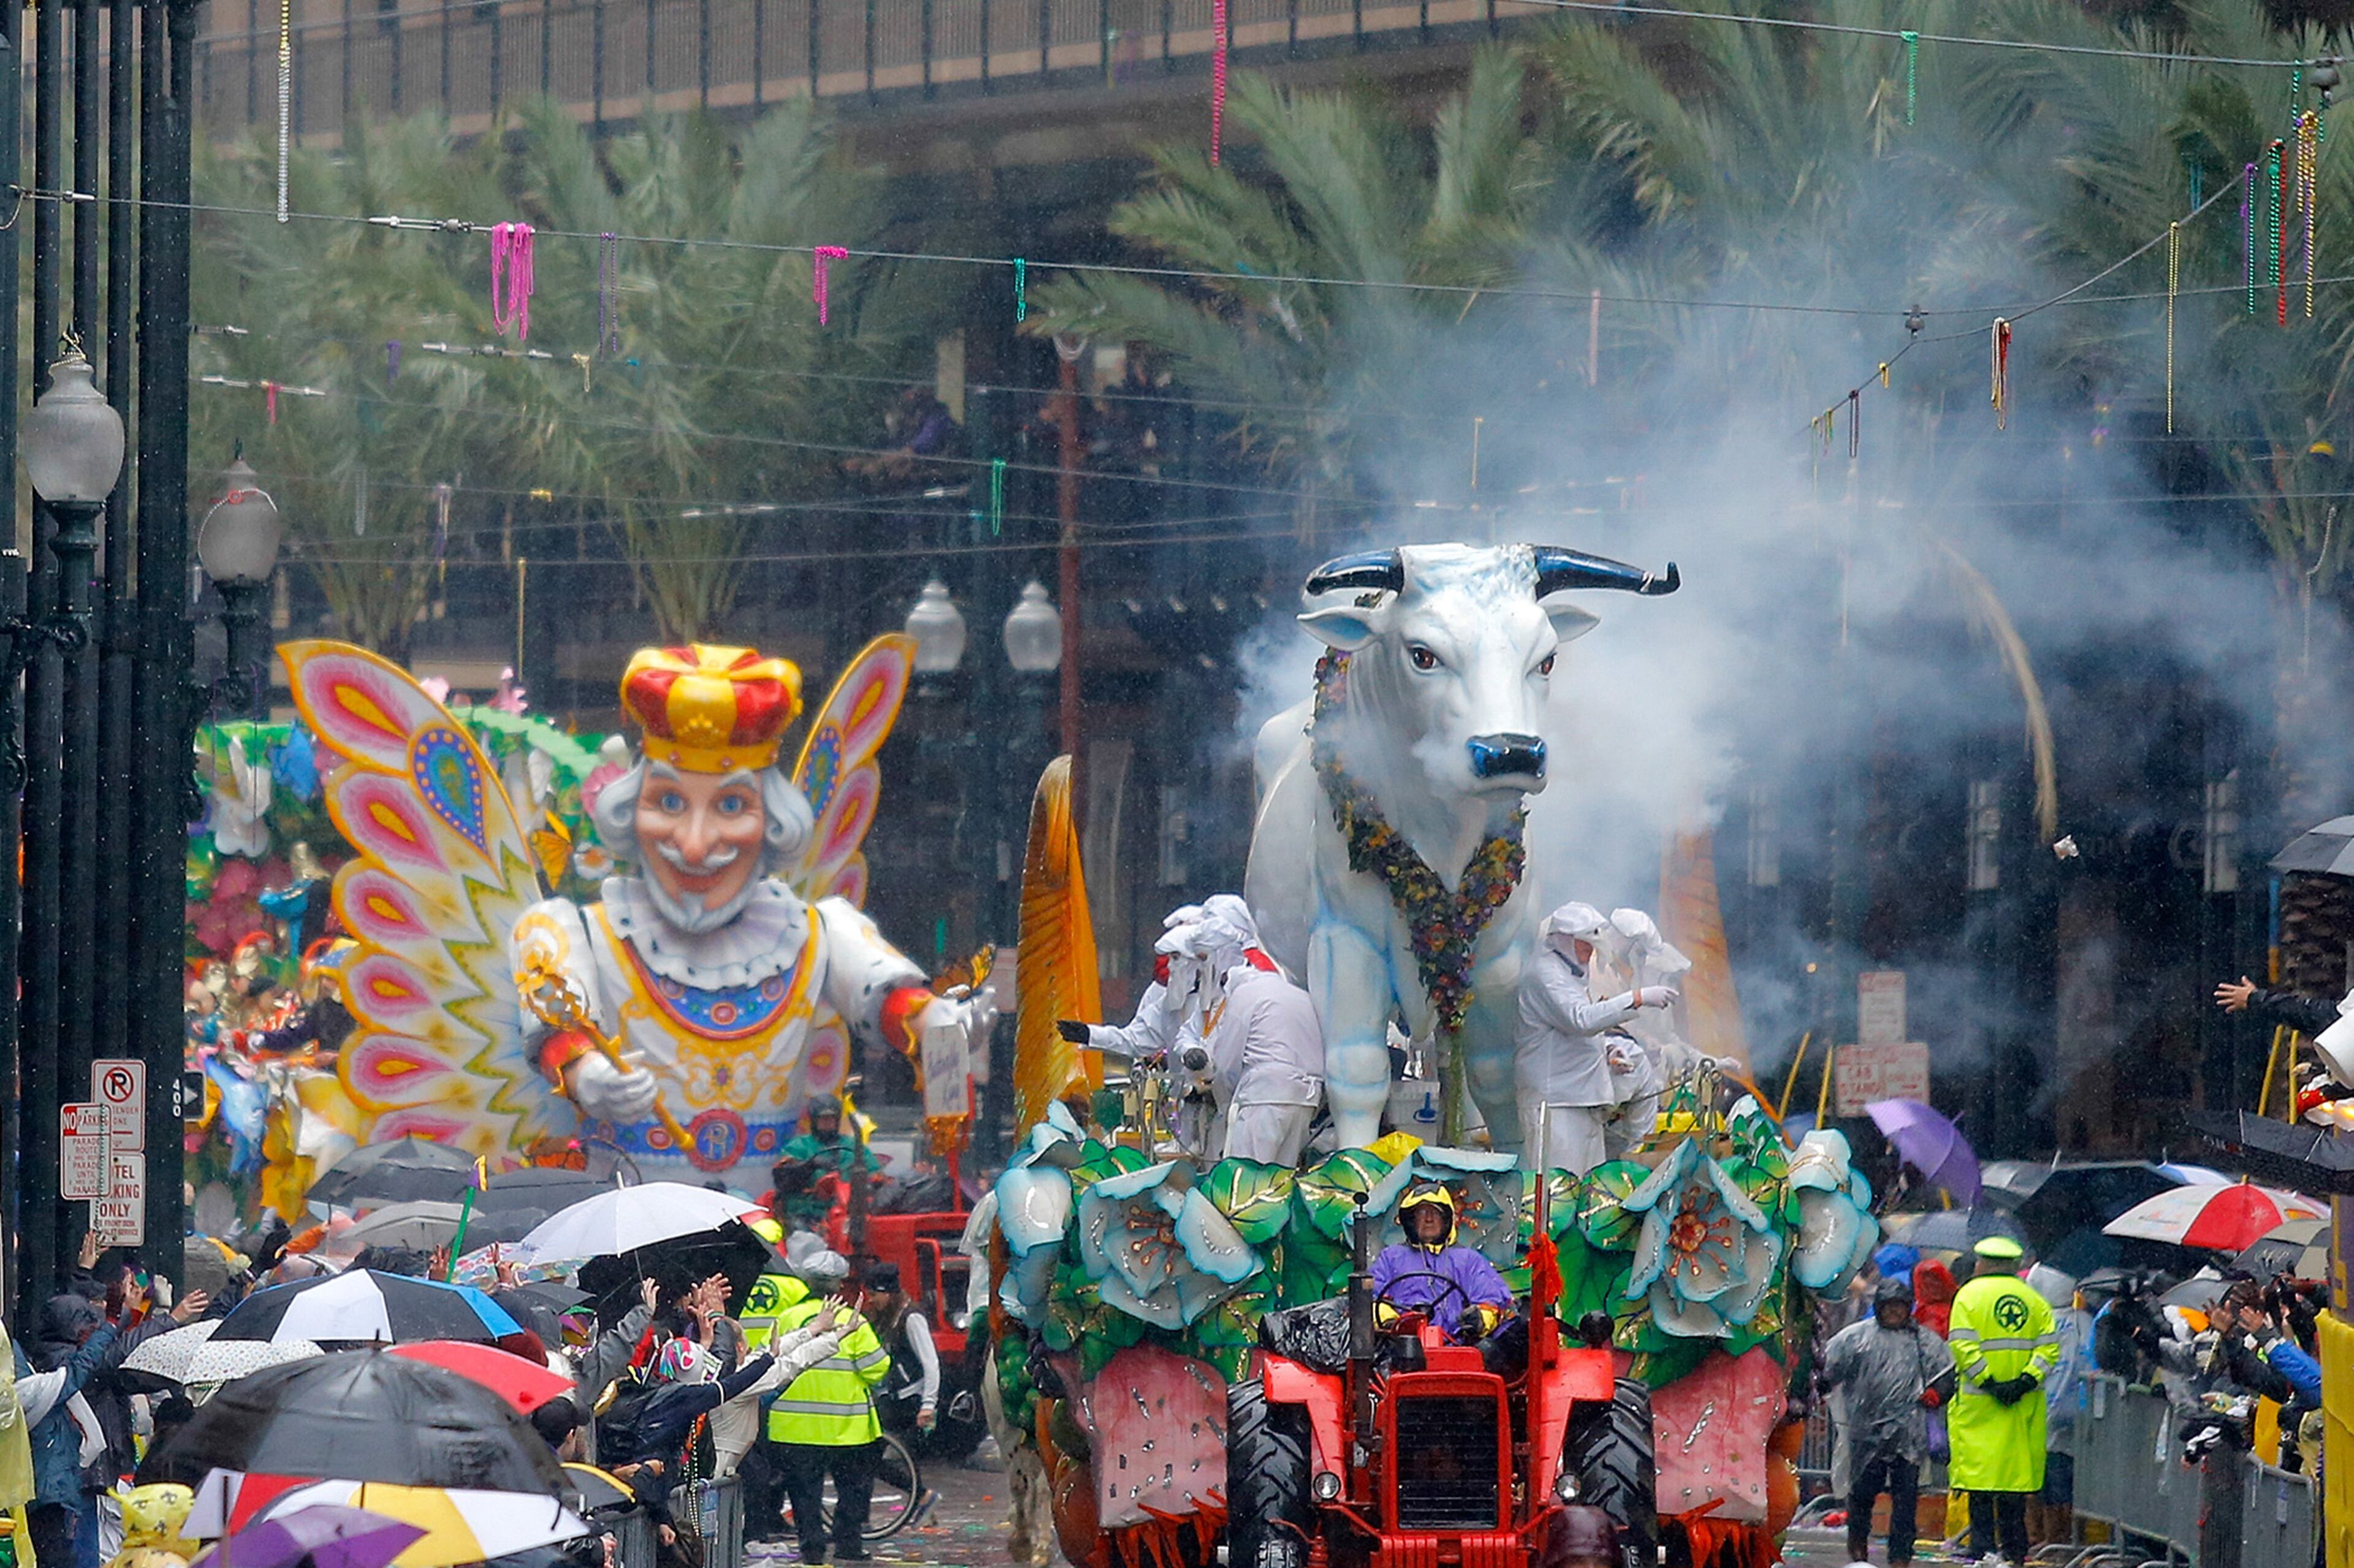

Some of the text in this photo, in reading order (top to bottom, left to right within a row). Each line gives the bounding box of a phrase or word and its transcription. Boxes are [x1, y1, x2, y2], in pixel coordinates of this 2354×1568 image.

[64, 1113, 109, 1129] NO PARKIG
[113, 1165, 135, 1179] TEL
[111, 1184, 140, 1198] KING
[100, 1203, 131, 1217] ONLY
